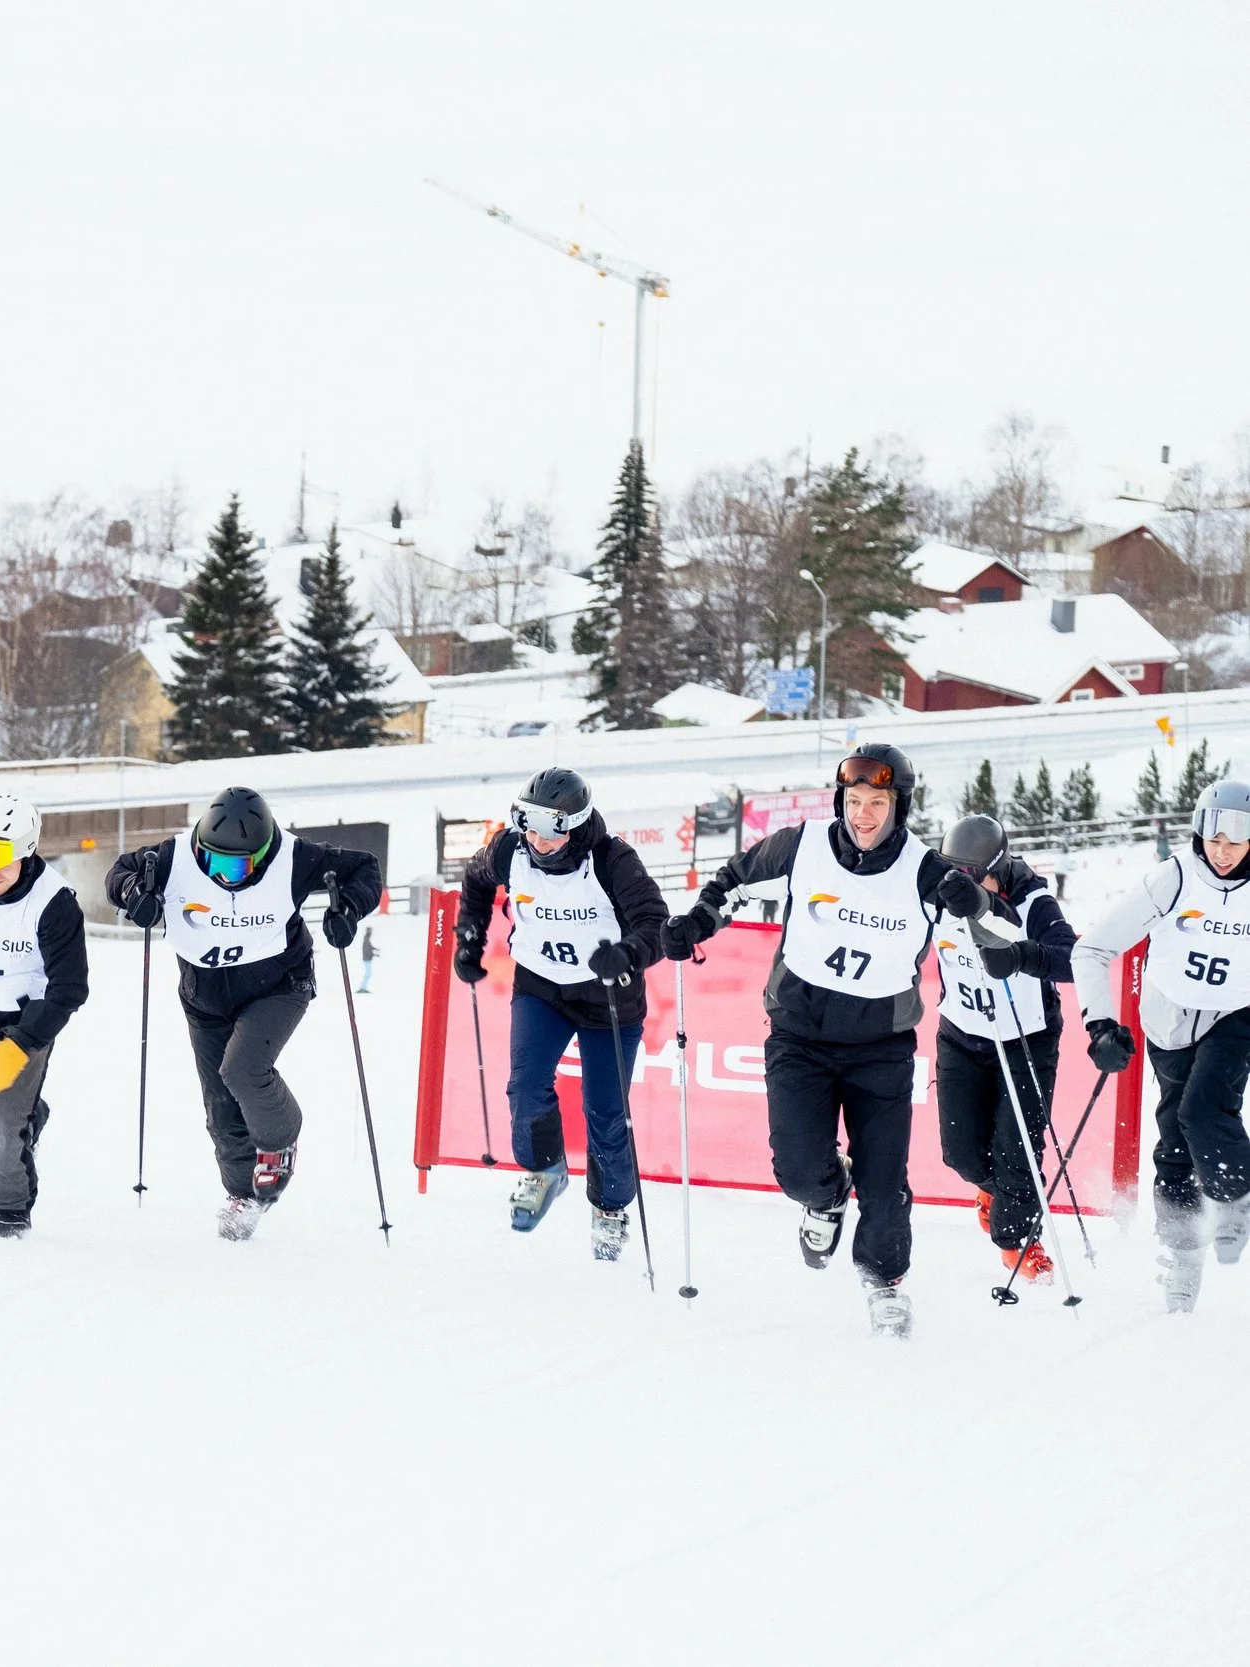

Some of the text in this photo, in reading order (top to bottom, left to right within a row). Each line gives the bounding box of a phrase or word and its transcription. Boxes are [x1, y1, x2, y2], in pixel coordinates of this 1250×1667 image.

[210, 914, 275, 928] CELSIUS
[535, 906, 598, 921] CELSIUS
[838, 908, 907, 931] CELSIUS
[199, 945, 244, 968] 49
[540, 941, 579, 966] 48
[824, 946, 872, 980] 47
[1184, 951, 1230, 986] 56
